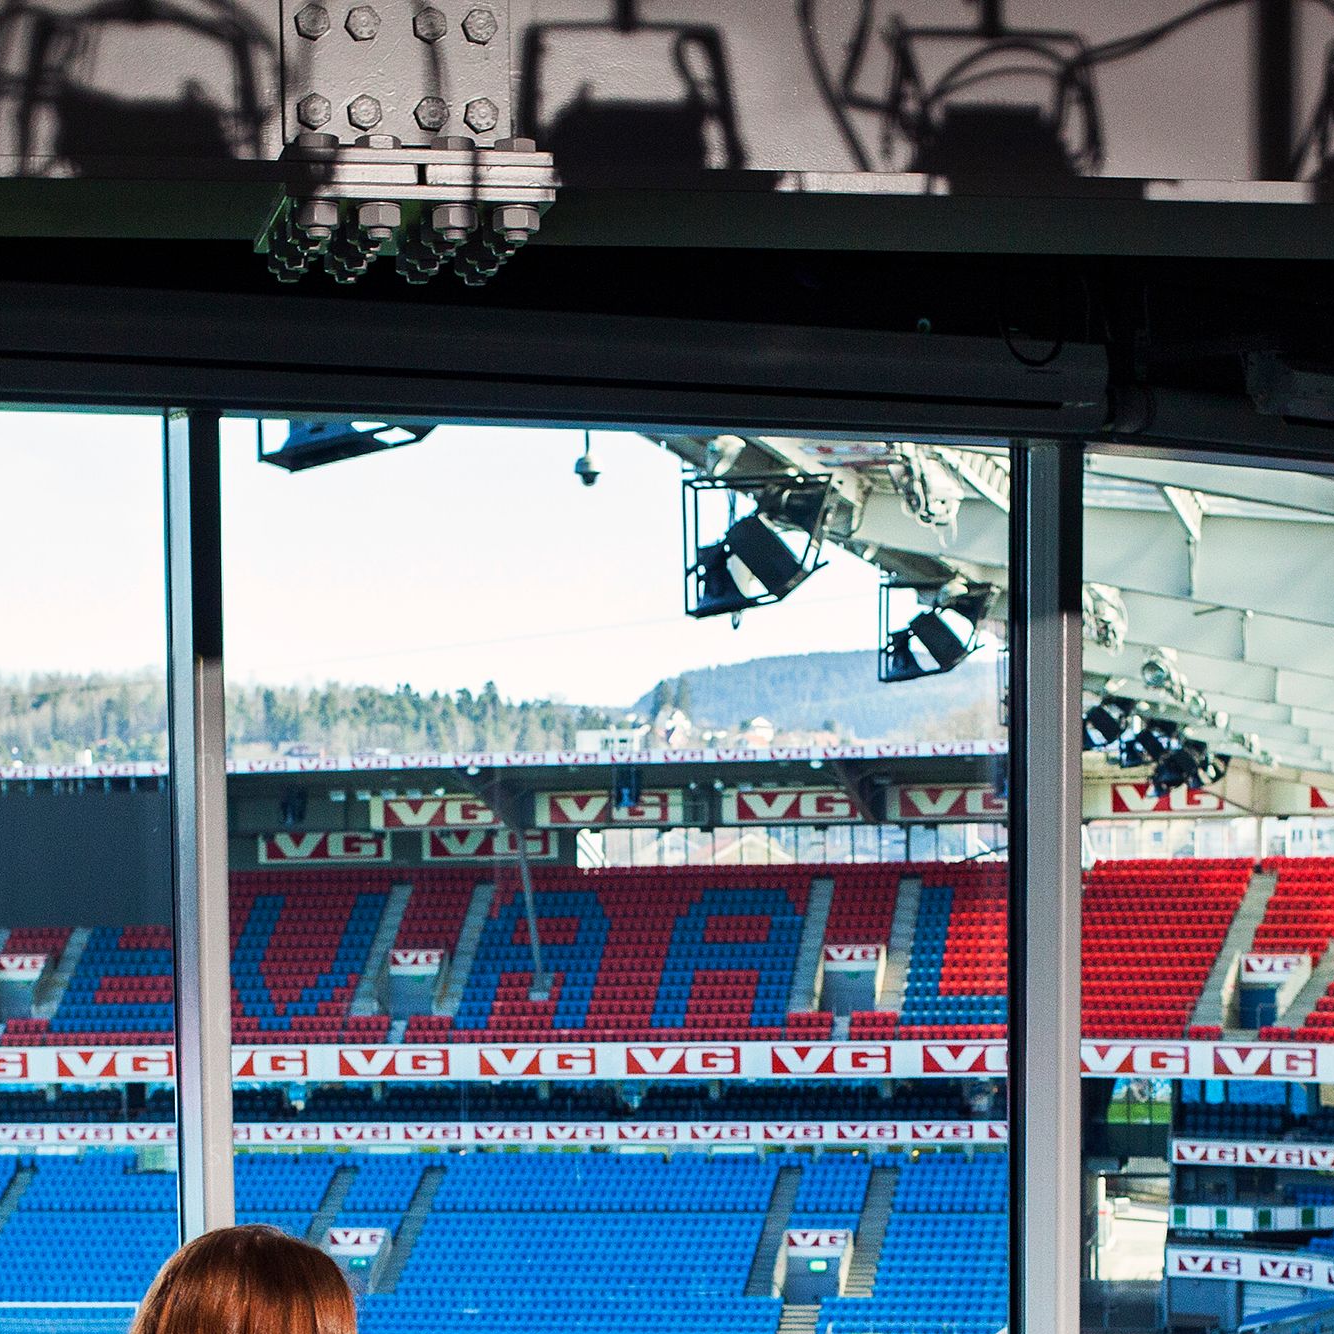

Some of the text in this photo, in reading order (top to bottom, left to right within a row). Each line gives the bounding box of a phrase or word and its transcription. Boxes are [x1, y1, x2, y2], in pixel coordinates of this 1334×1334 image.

[549, 794, 668, 821] VG
[737, 789, 862, 821] VG
[1111, 783, 1224, 813] VG
[383, 796, 505, 827] VG
[265, 832, 385, 859] VG
[429, 831, 550, 856] VG
[391, 951, 443, 967] VG
[825, 947, 878, 962] VG
[1244, 957, 1304, 973] VG
[57, 1052, 174, 1078] VG
[339, 1049, 449, 1077] VG
[479, 1048, 596, 1076] VG
[626, 1047, 741, 1075] VG
[771, 1046, 892, 1074] VG
[1080, 1046, 1189, 1075] VG
[1213, 1047, 1318, 1078] VG
[58, 1127, 114, 1141] VG
[264, 1126, 319, 1140] VG
[334, 1126, 390, 1140] VG
[405, 1126, 461, 1140] VG
[475, 1126, 532, 1140] VG
[547, 1126, 604, 1140] VG
[619, 1126, 677, 1140] VG
[691, 1126, 749, 1140] VG
[764, 1125, 823, 1140] VG
[838, 1125, 897, 1140] VG
[912, 1125, 973, 1140] VG
[1177, 1145, 1238, 1165] VG
[1246, 1147, 1304, 1168] VG
[330, 1231, 384, 1245] VG
[788, 1232, 848, 1246] VG
[1178, 1255, 1241, 1276] VG
[1260, 1260, 1313, 1282] VG
